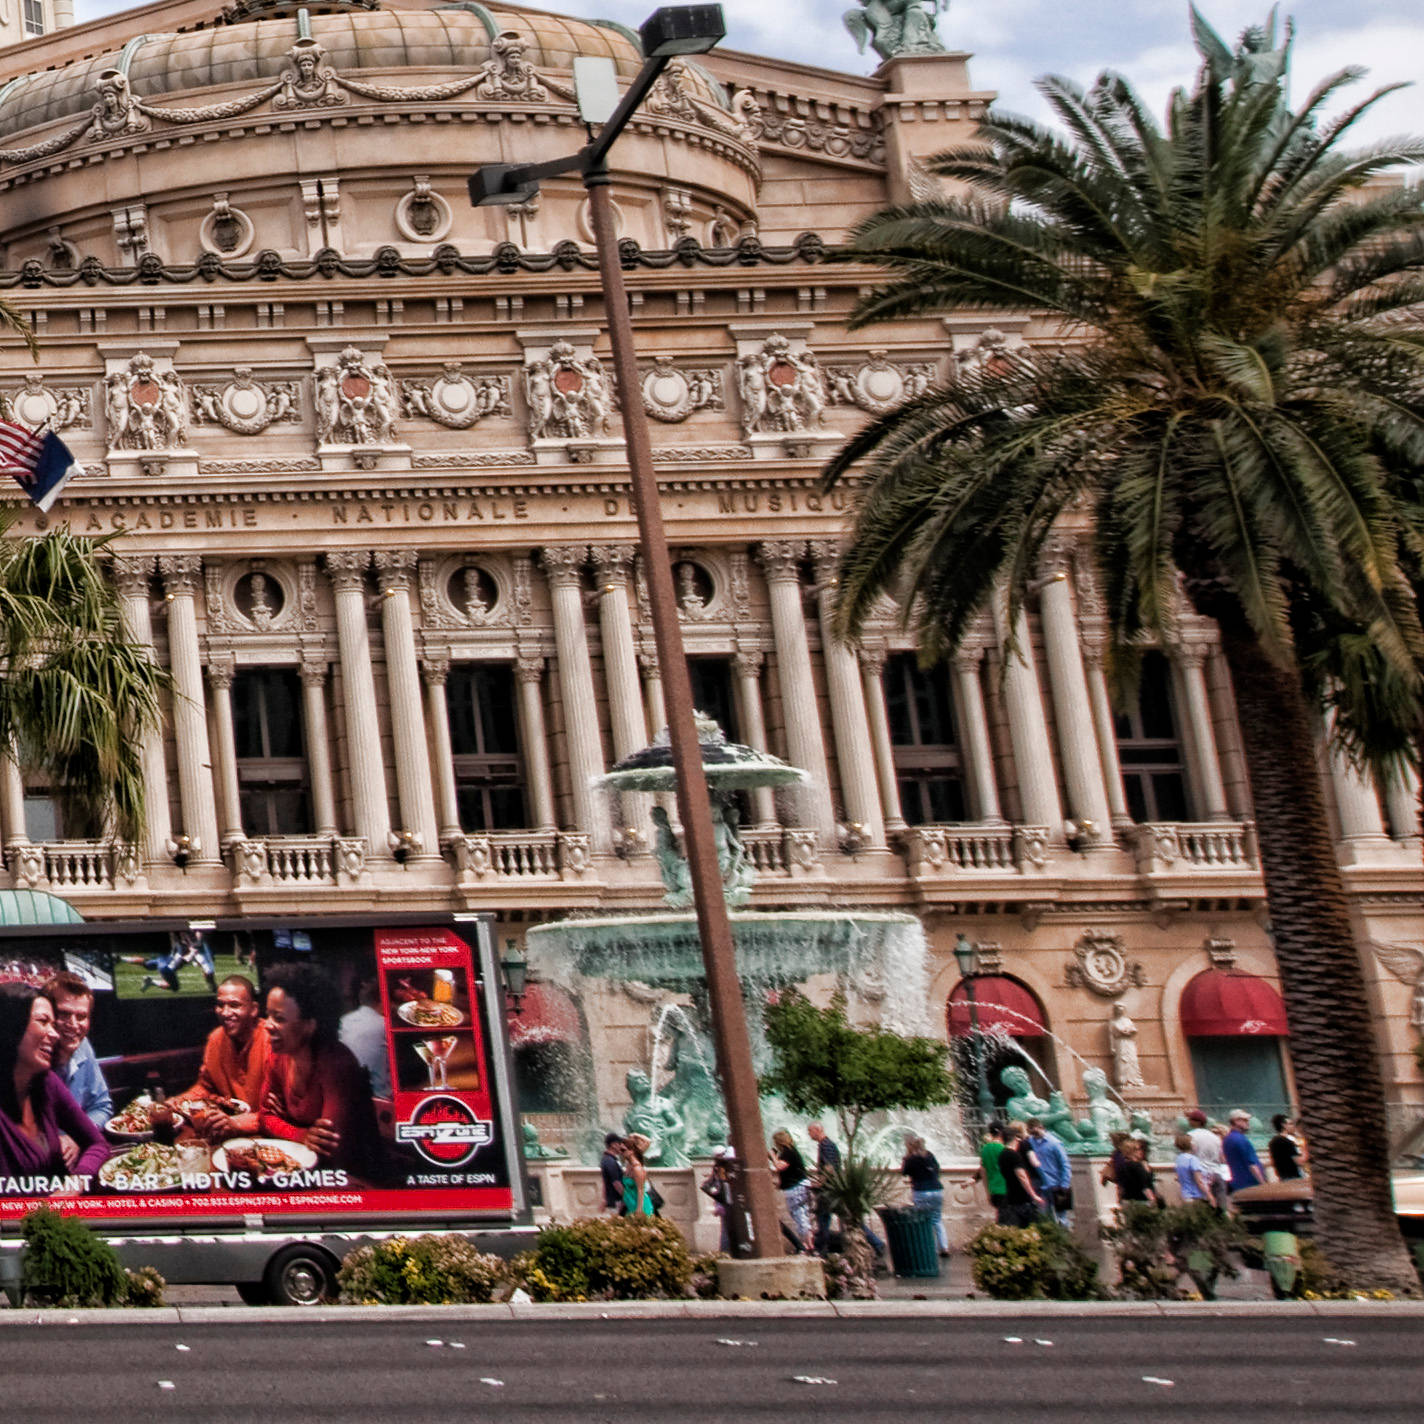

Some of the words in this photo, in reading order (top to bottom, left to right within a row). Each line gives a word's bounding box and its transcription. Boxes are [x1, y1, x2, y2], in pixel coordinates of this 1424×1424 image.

[86, 508, 257, 531] ACADEMIE
[332, 500, 529, 524] NATIONALE
[718, 492, 847, 514] MUSIQU
[116, 1174, 159, 1190] BAR
[181, 1171, 252, 1190] HDTVS
[272, 1169, 349, 1188] GAMES
[406, 1176, 415, 1184] A
[418, 1175, 448, 1184] TASTE
[450, 1174, 463, 1184] OF
[466, 1174, 495, 1183] ESPN
[1, 1201, 24, 1211] NEW
[107, 1198, 138, 1209] HOTEL
[148, 1197, 183, 1207] CASINO
[289, 1194, 363, 1205] ESPNZONE.COM
